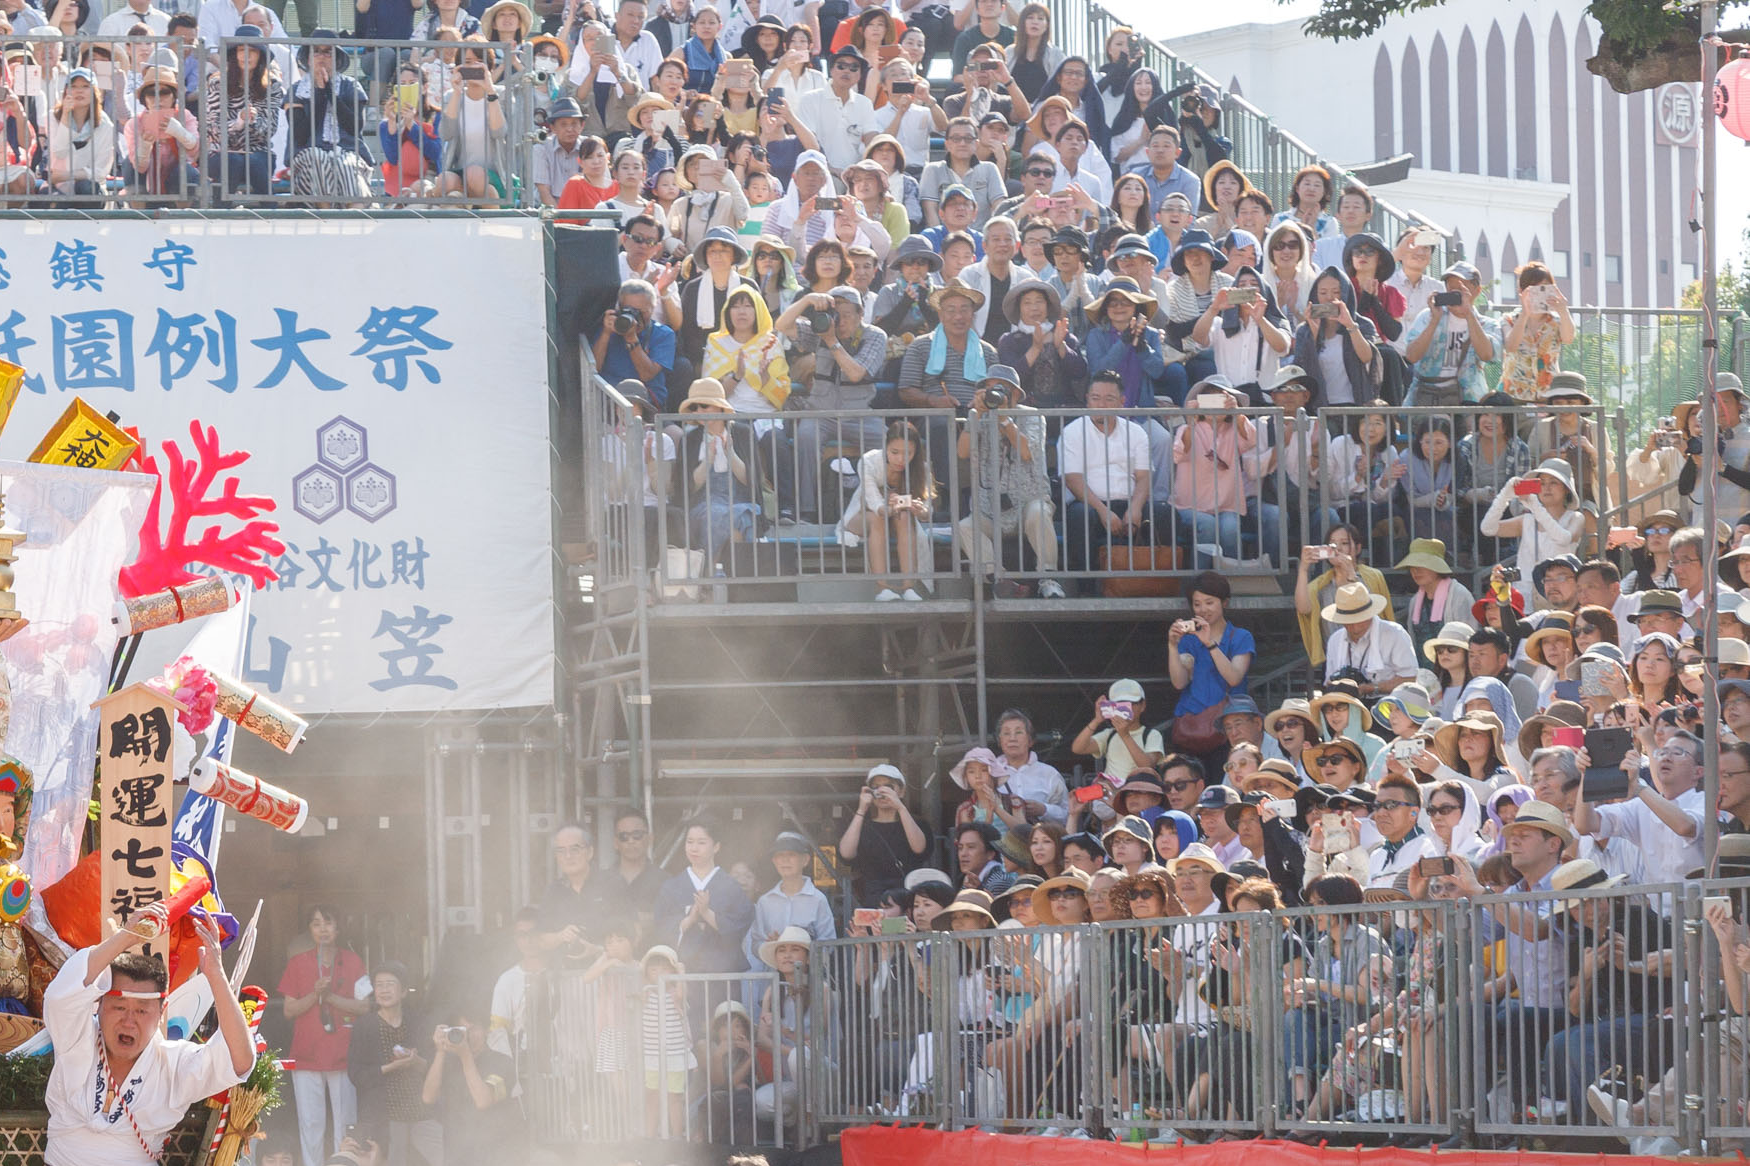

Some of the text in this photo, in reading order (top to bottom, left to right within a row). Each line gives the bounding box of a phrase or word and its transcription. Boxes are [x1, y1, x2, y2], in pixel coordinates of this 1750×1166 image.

[1664, 92, 1693, 133] 源
[109, 707, 172, 963] 開運七福
